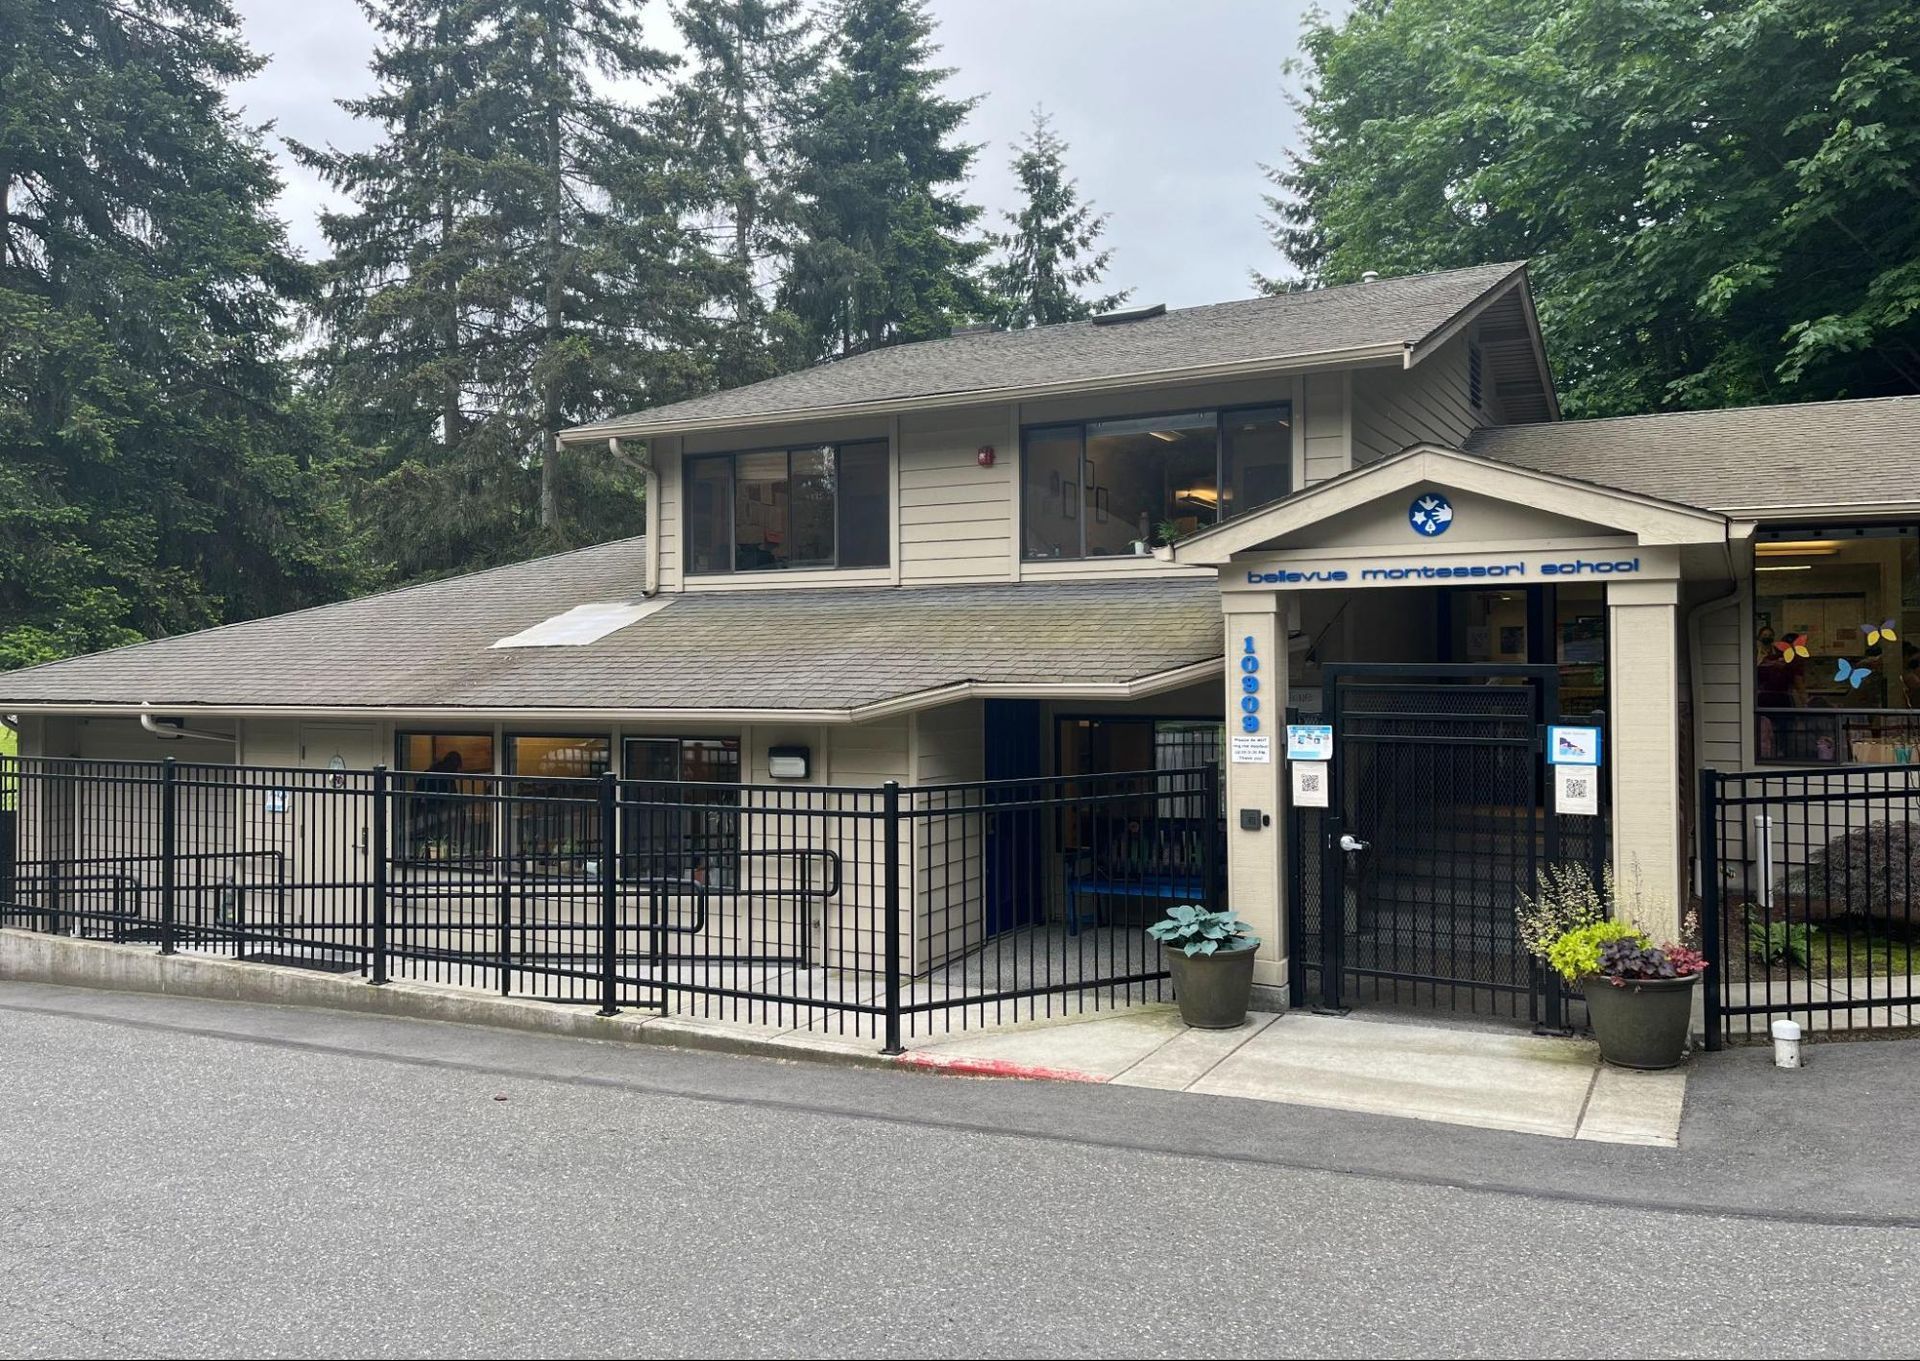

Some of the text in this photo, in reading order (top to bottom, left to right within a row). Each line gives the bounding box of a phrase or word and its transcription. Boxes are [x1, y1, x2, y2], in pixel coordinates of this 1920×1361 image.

[1247, 558, 1640, 584] bellevue montessori school
[1240, 635, 1260, 734] 10909
